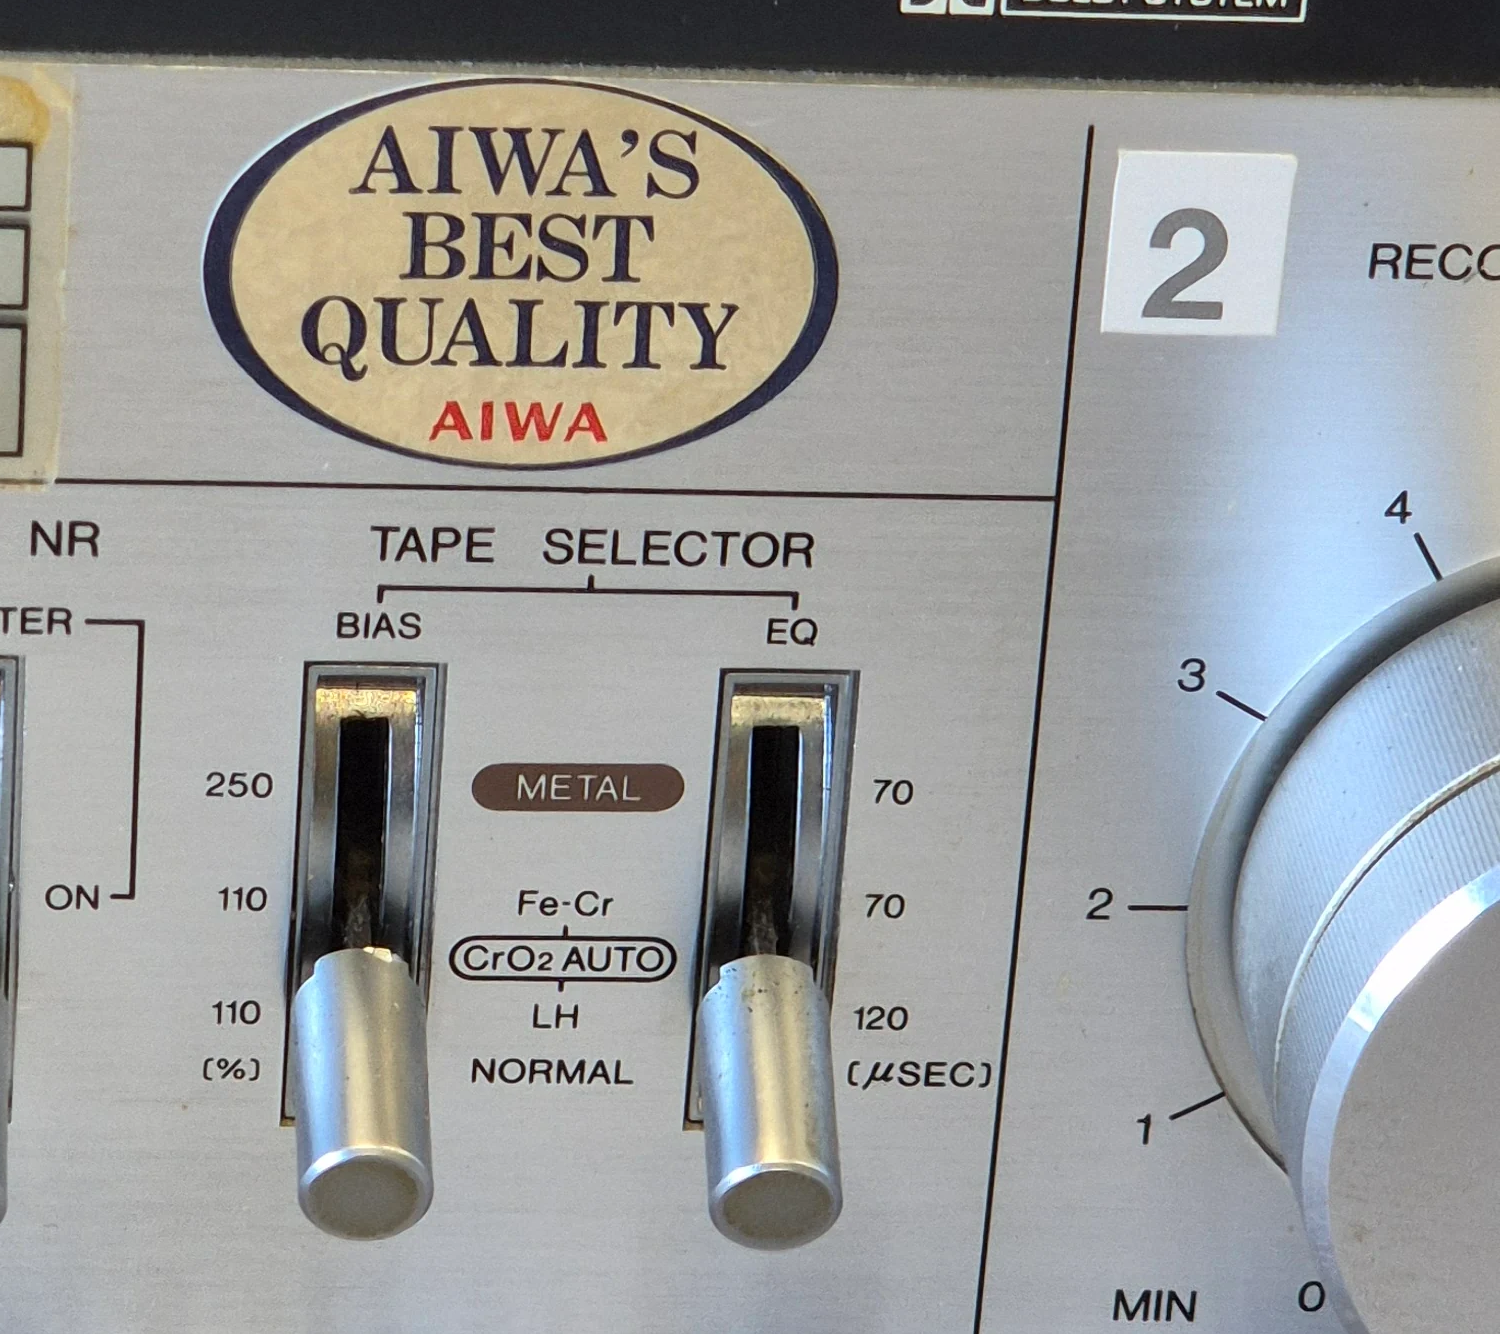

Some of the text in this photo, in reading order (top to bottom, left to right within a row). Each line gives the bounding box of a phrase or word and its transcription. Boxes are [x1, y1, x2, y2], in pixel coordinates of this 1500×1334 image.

[349, 126, 700, 199] AIWA'S
[399, 212, 655, 282] BEST
[1368, 243, 1500, 280] RECO
[1141, 207, 1229, 319] 2
[300, 296, 740, 382] QUALITY
[429, 401, 608, 442] AIWA
[1384, 490, 1412, 524] 4
[30, 522, 100, 557] NR
[370, 526, 815, 568] TAPE SELECTOR
[336, 612, 423, 640] BIAS
[766, 619, 819, 647] EQ
[1177, 658, 1207, 692] 3
[204, 772, 274, 798] 250
[516, 773, 641, 802] METAL
[873, 779, 914, 805] 70
[44, 884, 100, 911] ON
[218, 886, 268, 911] 110
[518, 889, 614, 916] Fe-Cr
[864, 893, 905, 919] 70
[1086, 887, 1114, 920] 2
[561, 946, 664, 972] AUTO
[211, 1000, 262, 1025] 110
[532, 1003, 579, 1029] LH
[853, 1006, 909, 1031] 120
[471, 1058, 634, 1085] NORMAL
[1137, 1114, 1153, 1145] 1
[1113, 1289, 1198, 1323] MIN
[1298, 1281, 1326, 1312] 0
